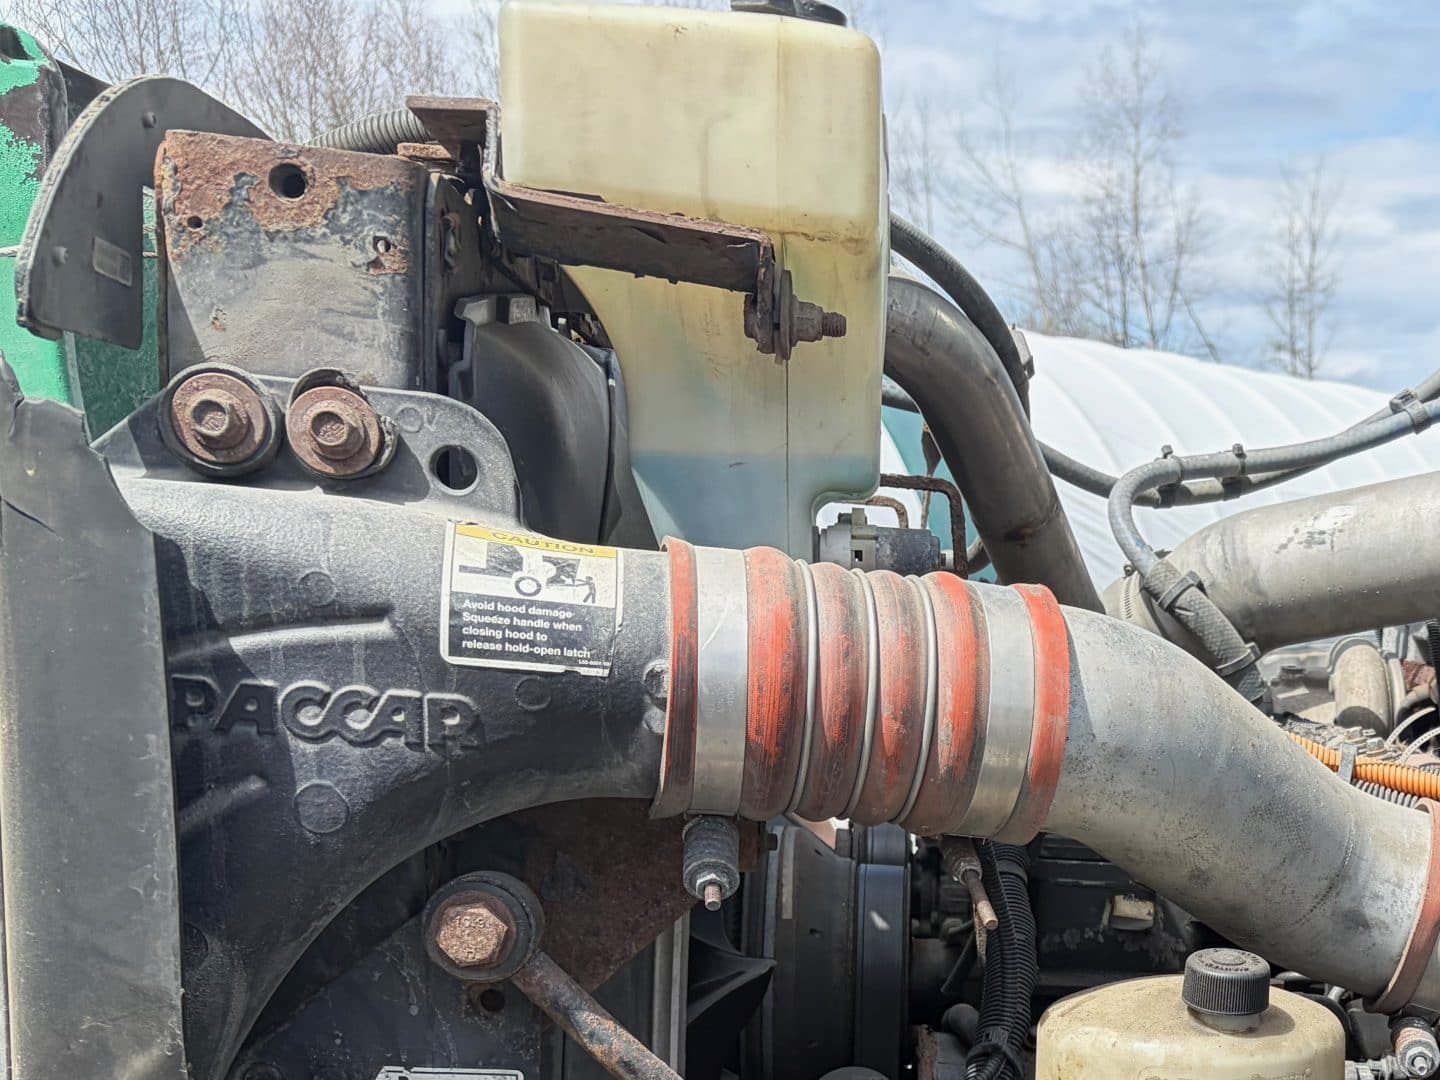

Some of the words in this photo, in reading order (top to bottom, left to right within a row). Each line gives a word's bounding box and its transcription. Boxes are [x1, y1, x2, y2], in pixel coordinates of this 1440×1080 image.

[491, 532, 594, 555] CAUTION
[463, 599, 495, 611] Avoid
[497, 602, 526, 614] hood
[528, 605, 573, 619] damage
[462, 612, 511, 626] Squeeze
[513, 616, 550, 629] handle
[553, 621, 582, 632] when
[462, 626, 503, 640] closing
[505, 629, 533, 641] hood
[536, 632, 548, 642] to
[462, 640, 502, 652] release
[505, 642, 561, 657] hold-open
[563, 646, 591, 659] latch
[171, 673, 485, 755] PACCAR
